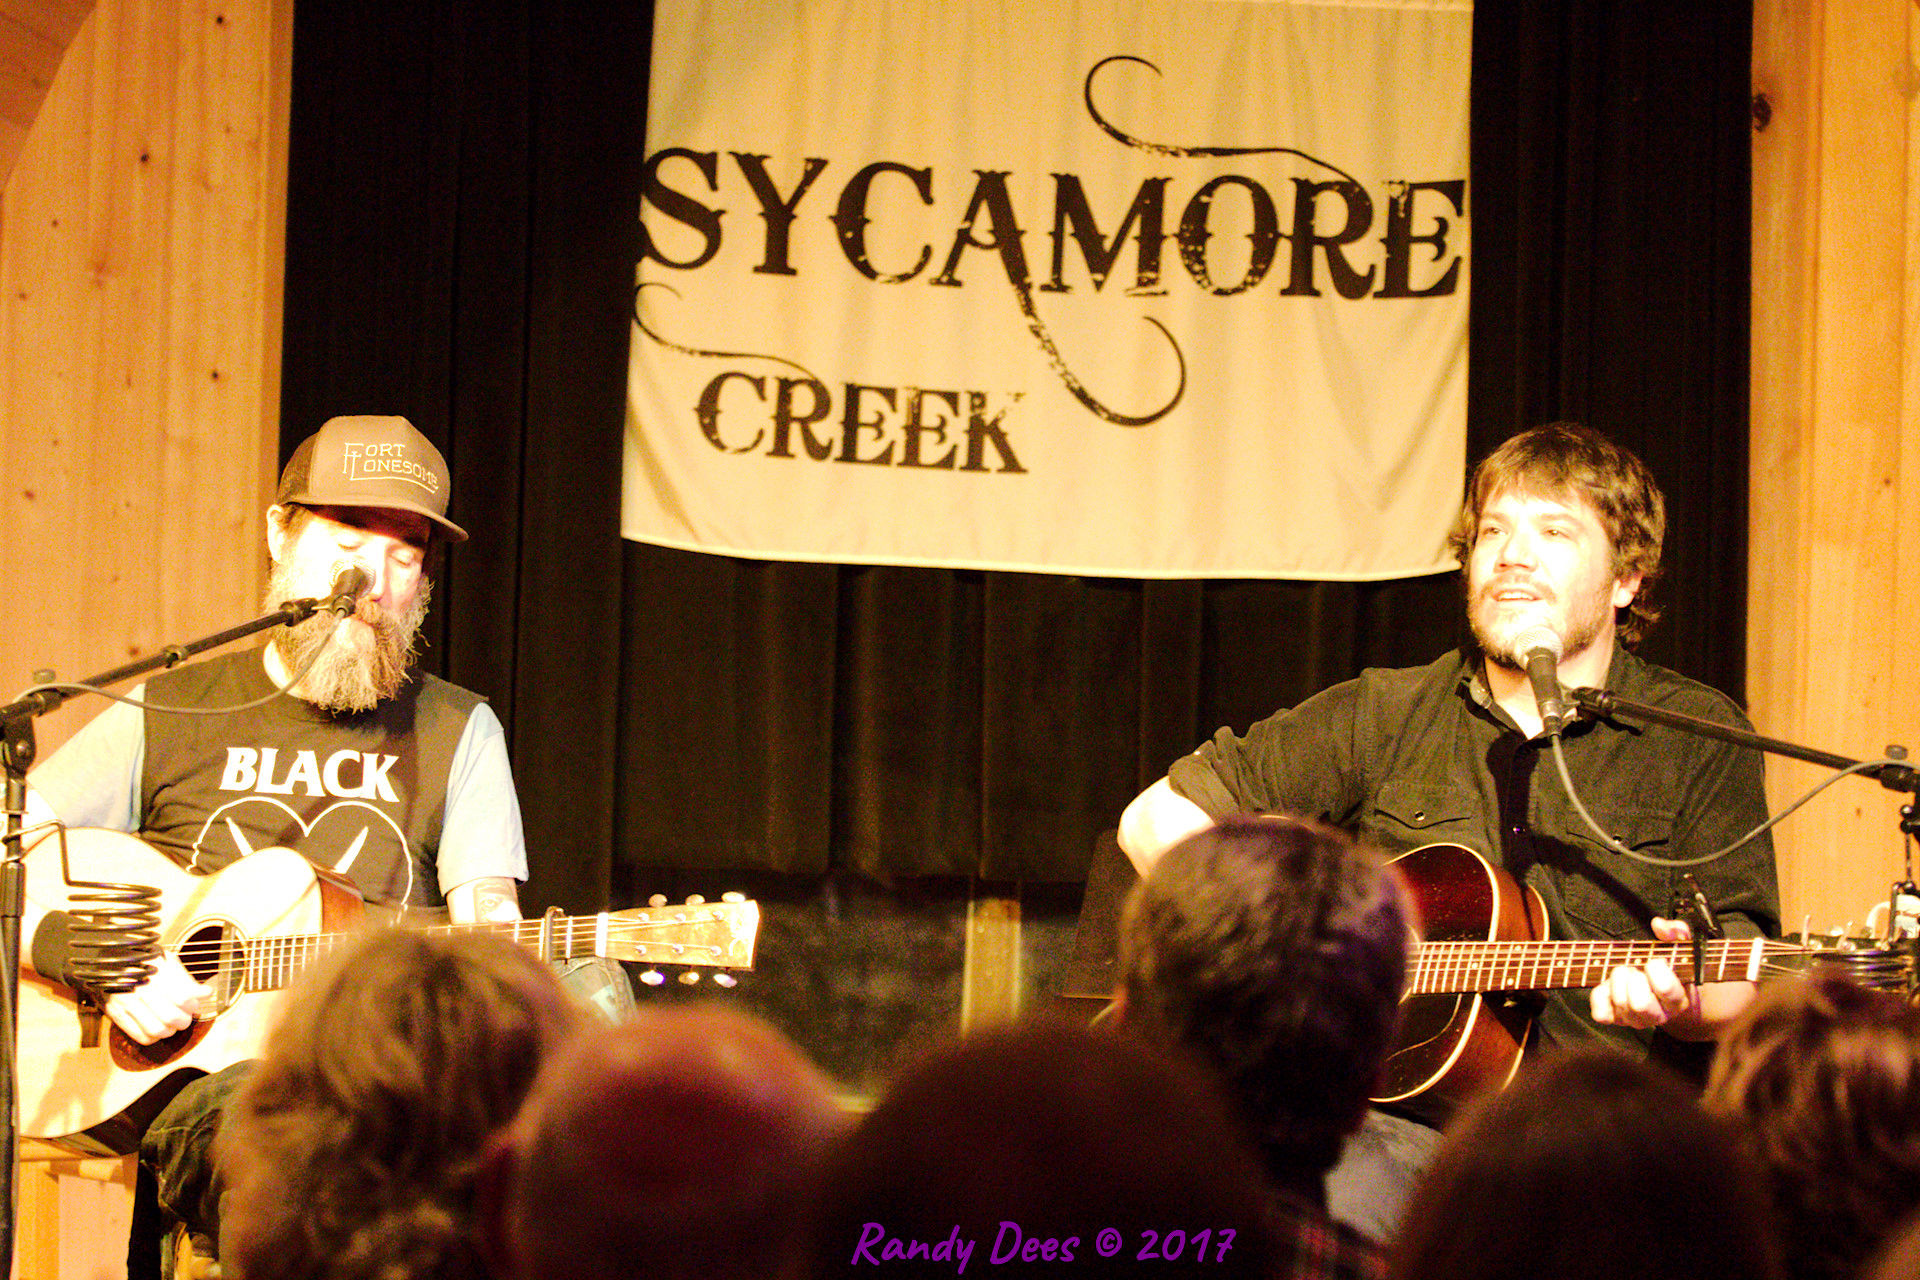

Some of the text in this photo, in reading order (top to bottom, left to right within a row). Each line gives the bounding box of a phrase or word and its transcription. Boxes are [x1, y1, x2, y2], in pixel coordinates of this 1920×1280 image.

[638, 146, 1465, 299] SYCAMORE
[695, 371, 1029, 474] CREEK
[342, 442, 406, 474] FORT
[349, 450, 439, 494] LONESOME
[219, 746, 400, 803] BLACK
